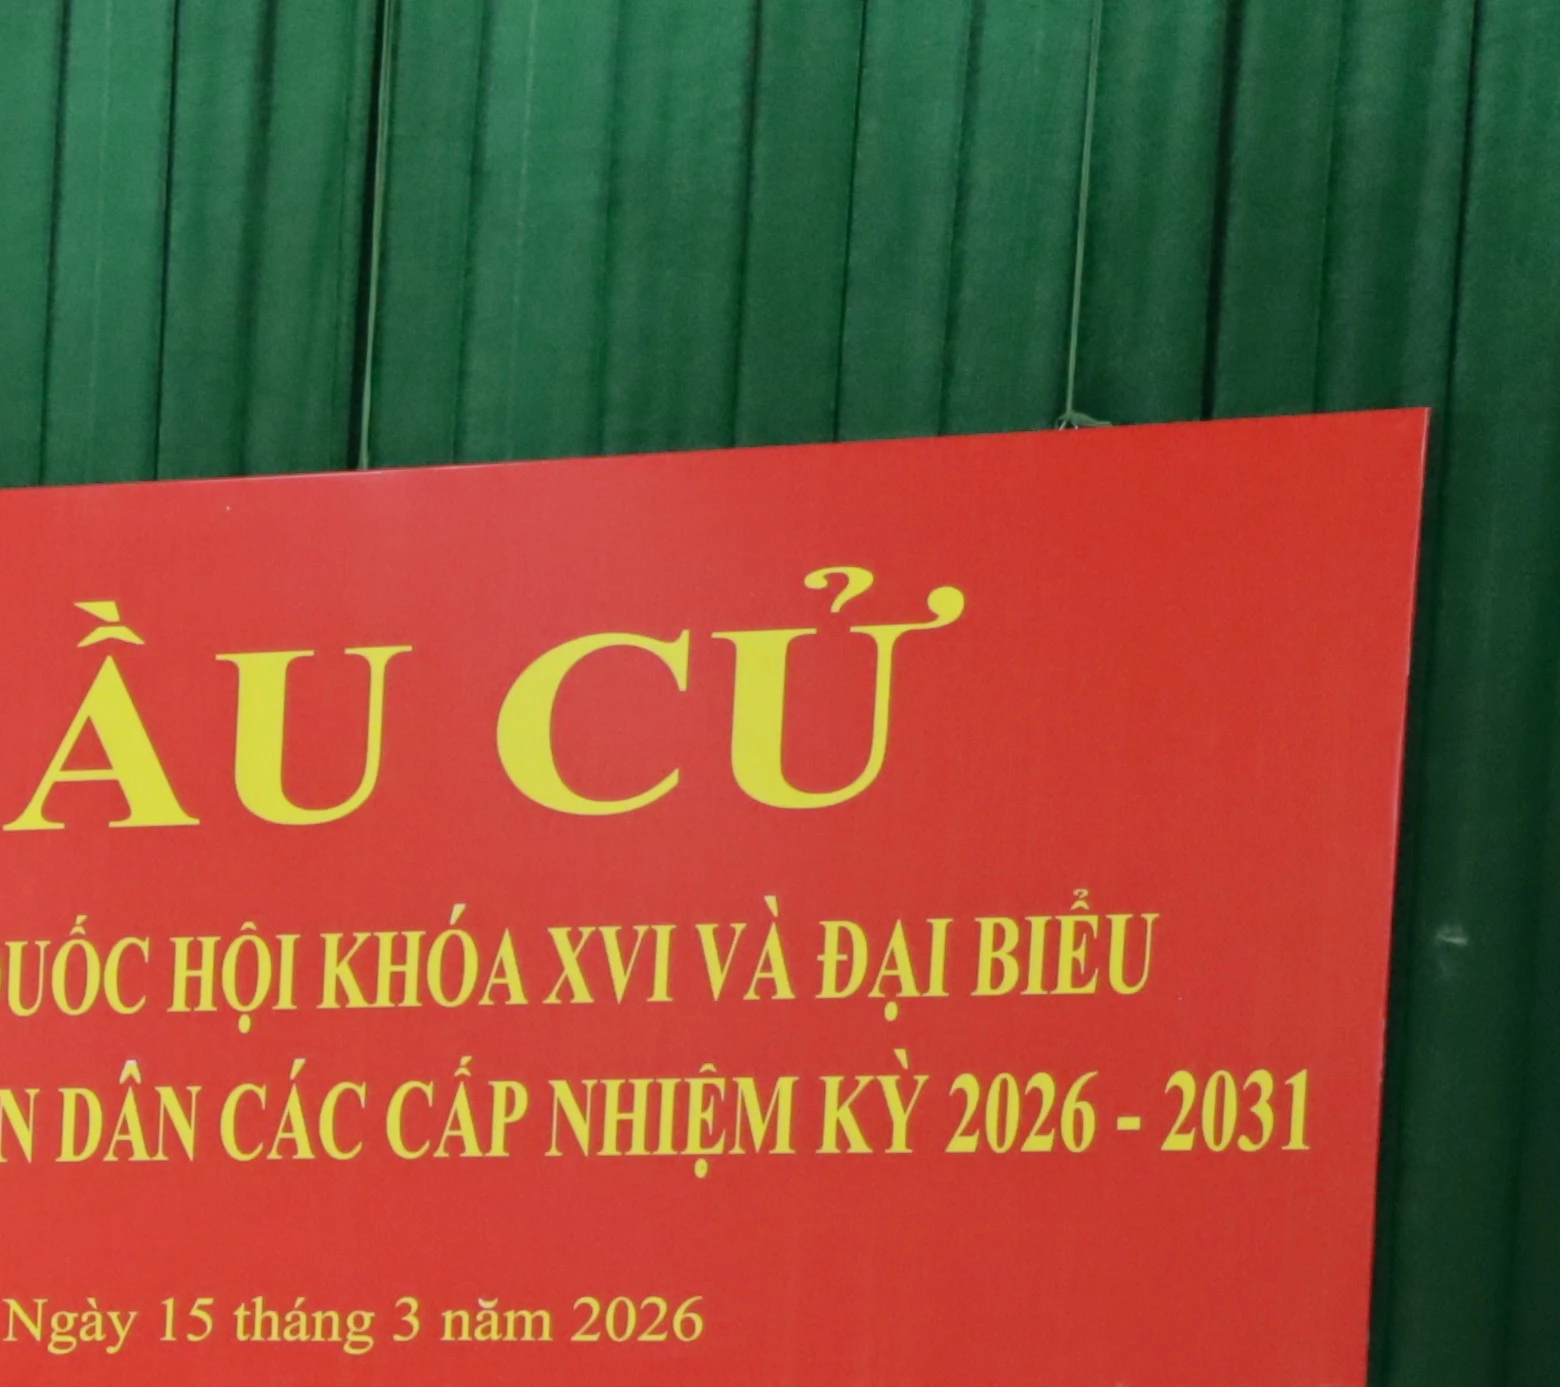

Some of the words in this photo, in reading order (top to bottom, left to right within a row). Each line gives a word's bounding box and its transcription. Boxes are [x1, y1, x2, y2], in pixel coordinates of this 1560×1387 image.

[495, 565, 966, 817] CỬ
[166, 920, 301, 1035] HỘI
[316, 902, 529, 1010] KHÓA
[542, 923, 678, 1005] XVI
[694, 894, 797, 1002] VÀ
[815, 917, 954, 1022] ĐẠI
[970, 888, 1160, 997] BIỂU
[55, 1058, 203, 1163] DÂN
[219, 1057, 367, 1162] CÁC
[385, 1055, 530, 1160] CẤP
[544, 1062, 800, 1179] NHIỆM
[815, 1047, 930, 1154] KỲ
[944, 1070, 1098, 1154] 2026
[1116, 1115, 1142, 1131] -
[1160, 1068, 1310, 1153] 2031
[2, 1296, 139, 1356] Ngày
[159, 1296, 215, 1343] 15
[232, 1295, 376, 1356] tháng
[392, 1295, 421, 1342] 3
[440, 1297, 554, 1342] năm
[570, 1295, 705, 1343] 2026
